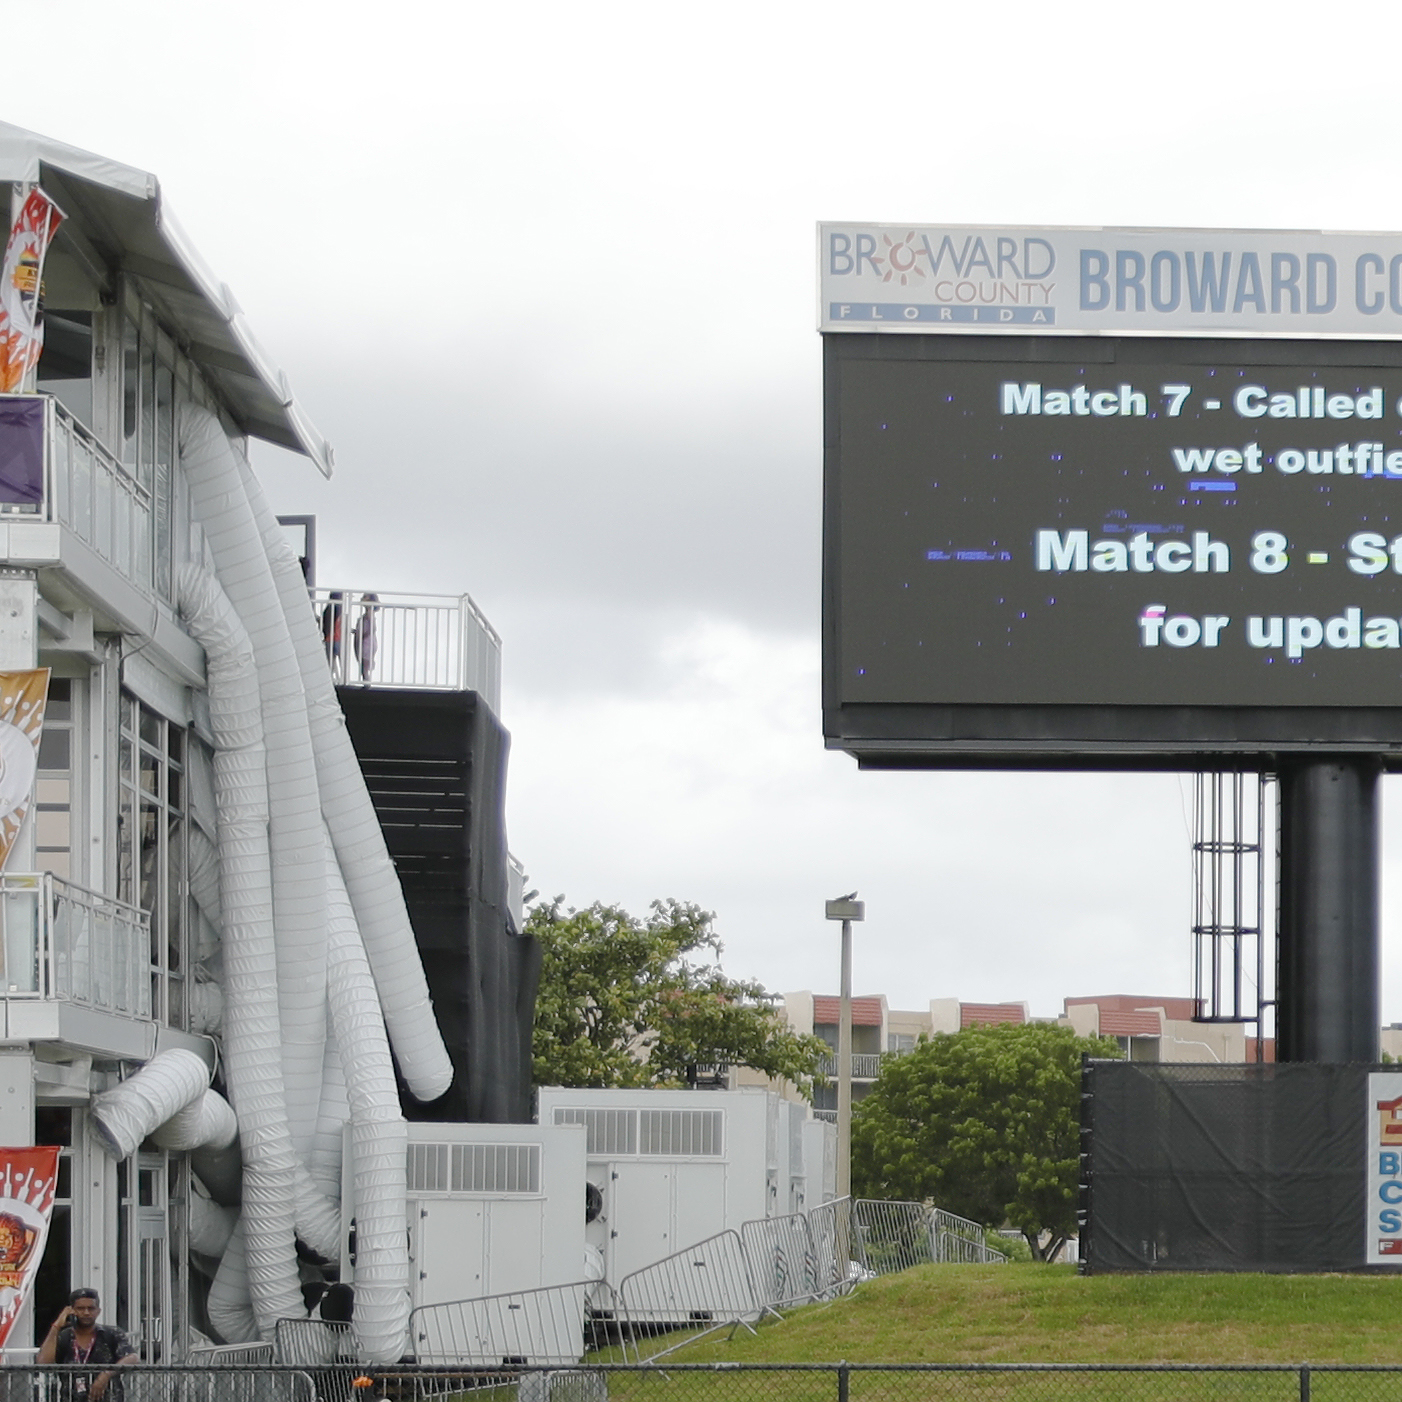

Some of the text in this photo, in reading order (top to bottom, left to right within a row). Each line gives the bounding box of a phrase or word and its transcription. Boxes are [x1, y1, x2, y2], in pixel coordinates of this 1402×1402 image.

[935, 281, 1057, 305] COUNTY
[1079, 248, 1338, 316] BROWARD
[840, 304, 1047, 323] FLORIDA
[1002, 383, 1148, 417] Match
[1161, 385, 1192, 417] 7
[1236, 386, 1384, 419] Called
[1173, 442, 1264, 474] wet
[1037, 530, 1231, 573] Match
[1251, 531, 1289, 574] 8
[1140, 605, 1230, 648] for
